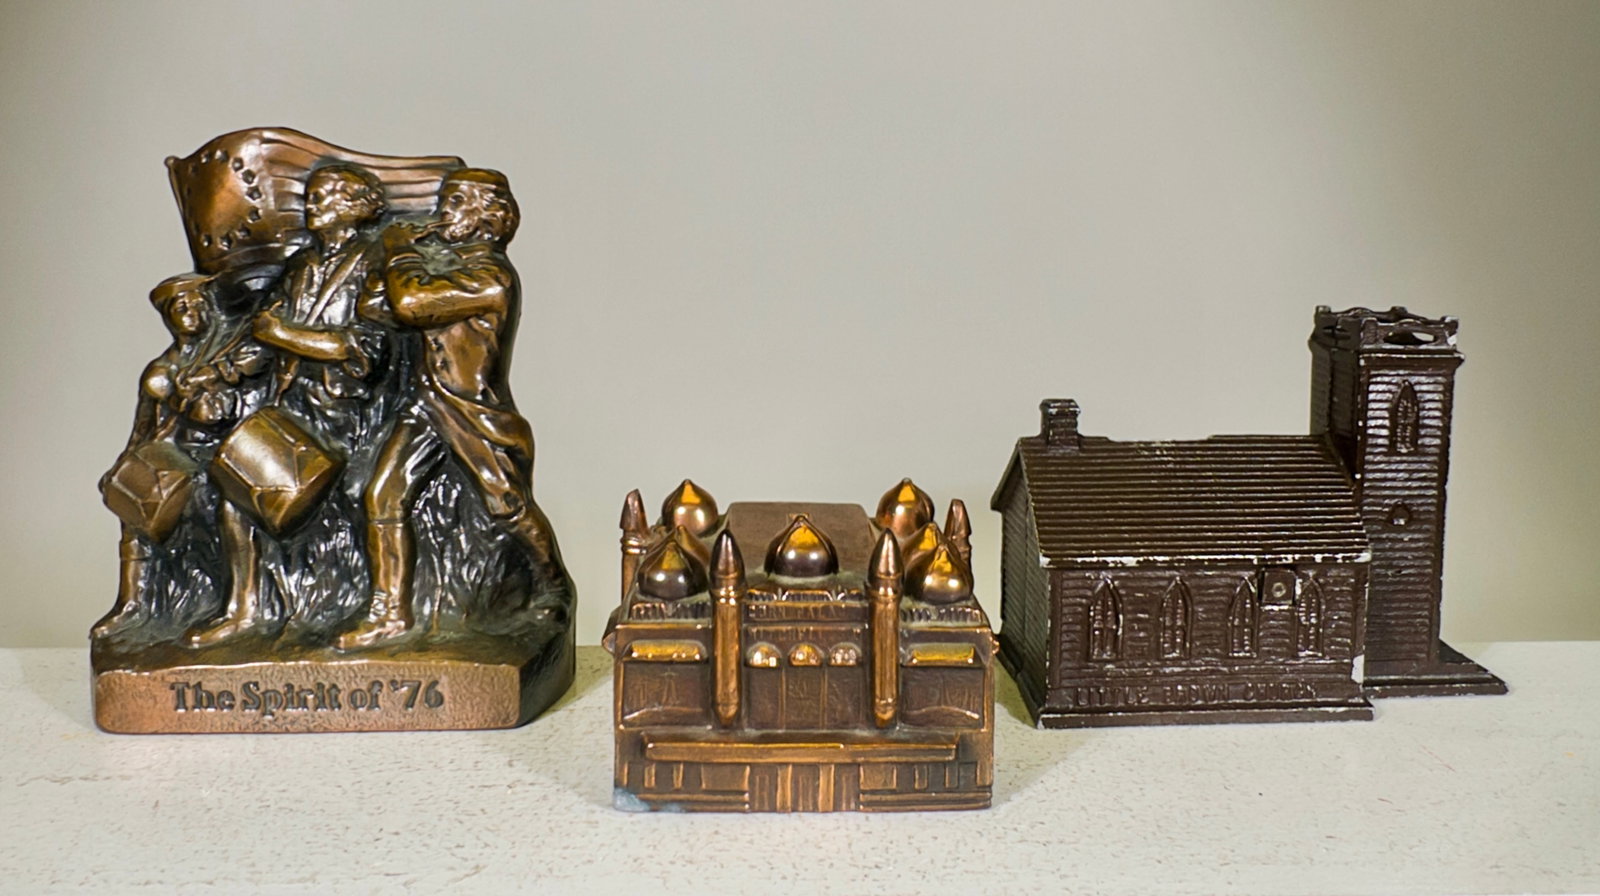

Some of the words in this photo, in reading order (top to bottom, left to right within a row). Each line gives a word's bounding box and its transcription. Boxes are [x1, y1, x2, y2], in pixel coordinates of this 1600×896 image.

[169, 680, 236, 713] The
[243, 680, 343, 719] Spirit
[350, 679, 384, 712] of
[1077, 685, 1150, 707] LITTLE
[1162, 683, 1229, 704] BROWN
